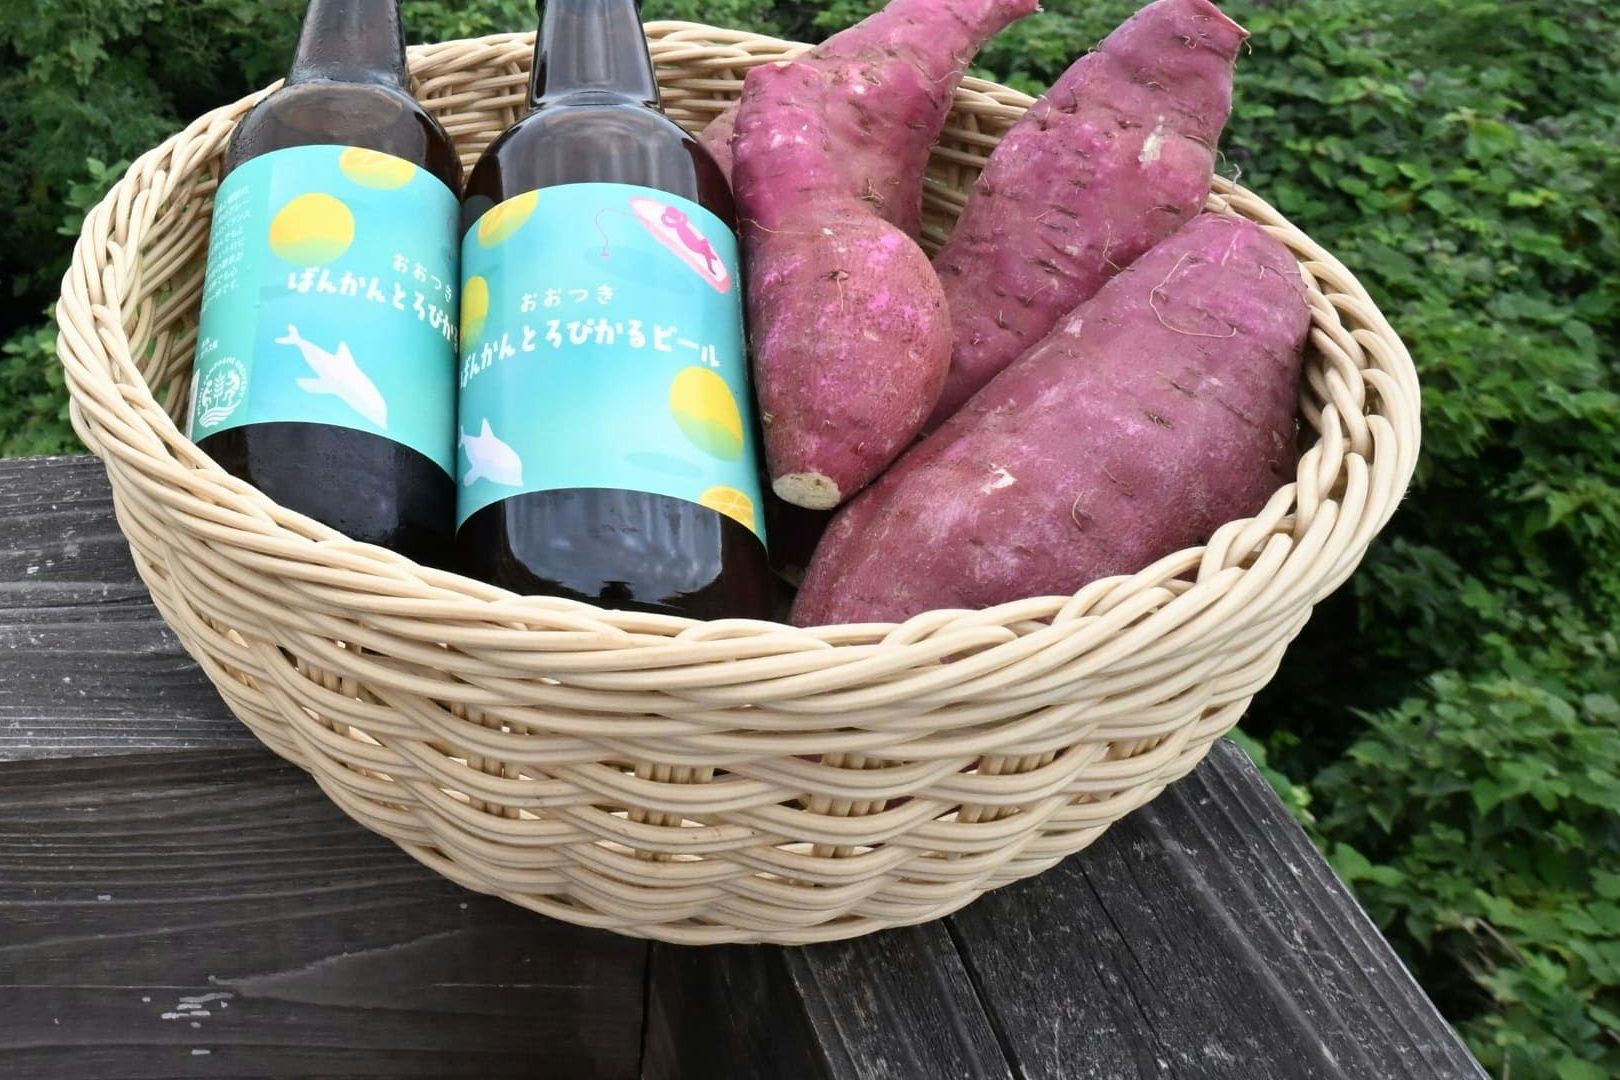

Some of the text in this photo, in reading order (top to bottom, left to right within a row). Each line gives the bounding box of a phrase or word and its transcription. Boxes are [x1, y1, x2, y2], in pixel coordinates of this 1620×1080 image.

[393, 253, 452, 302] おおつき
[521, 284, 613, 312] おおつき
